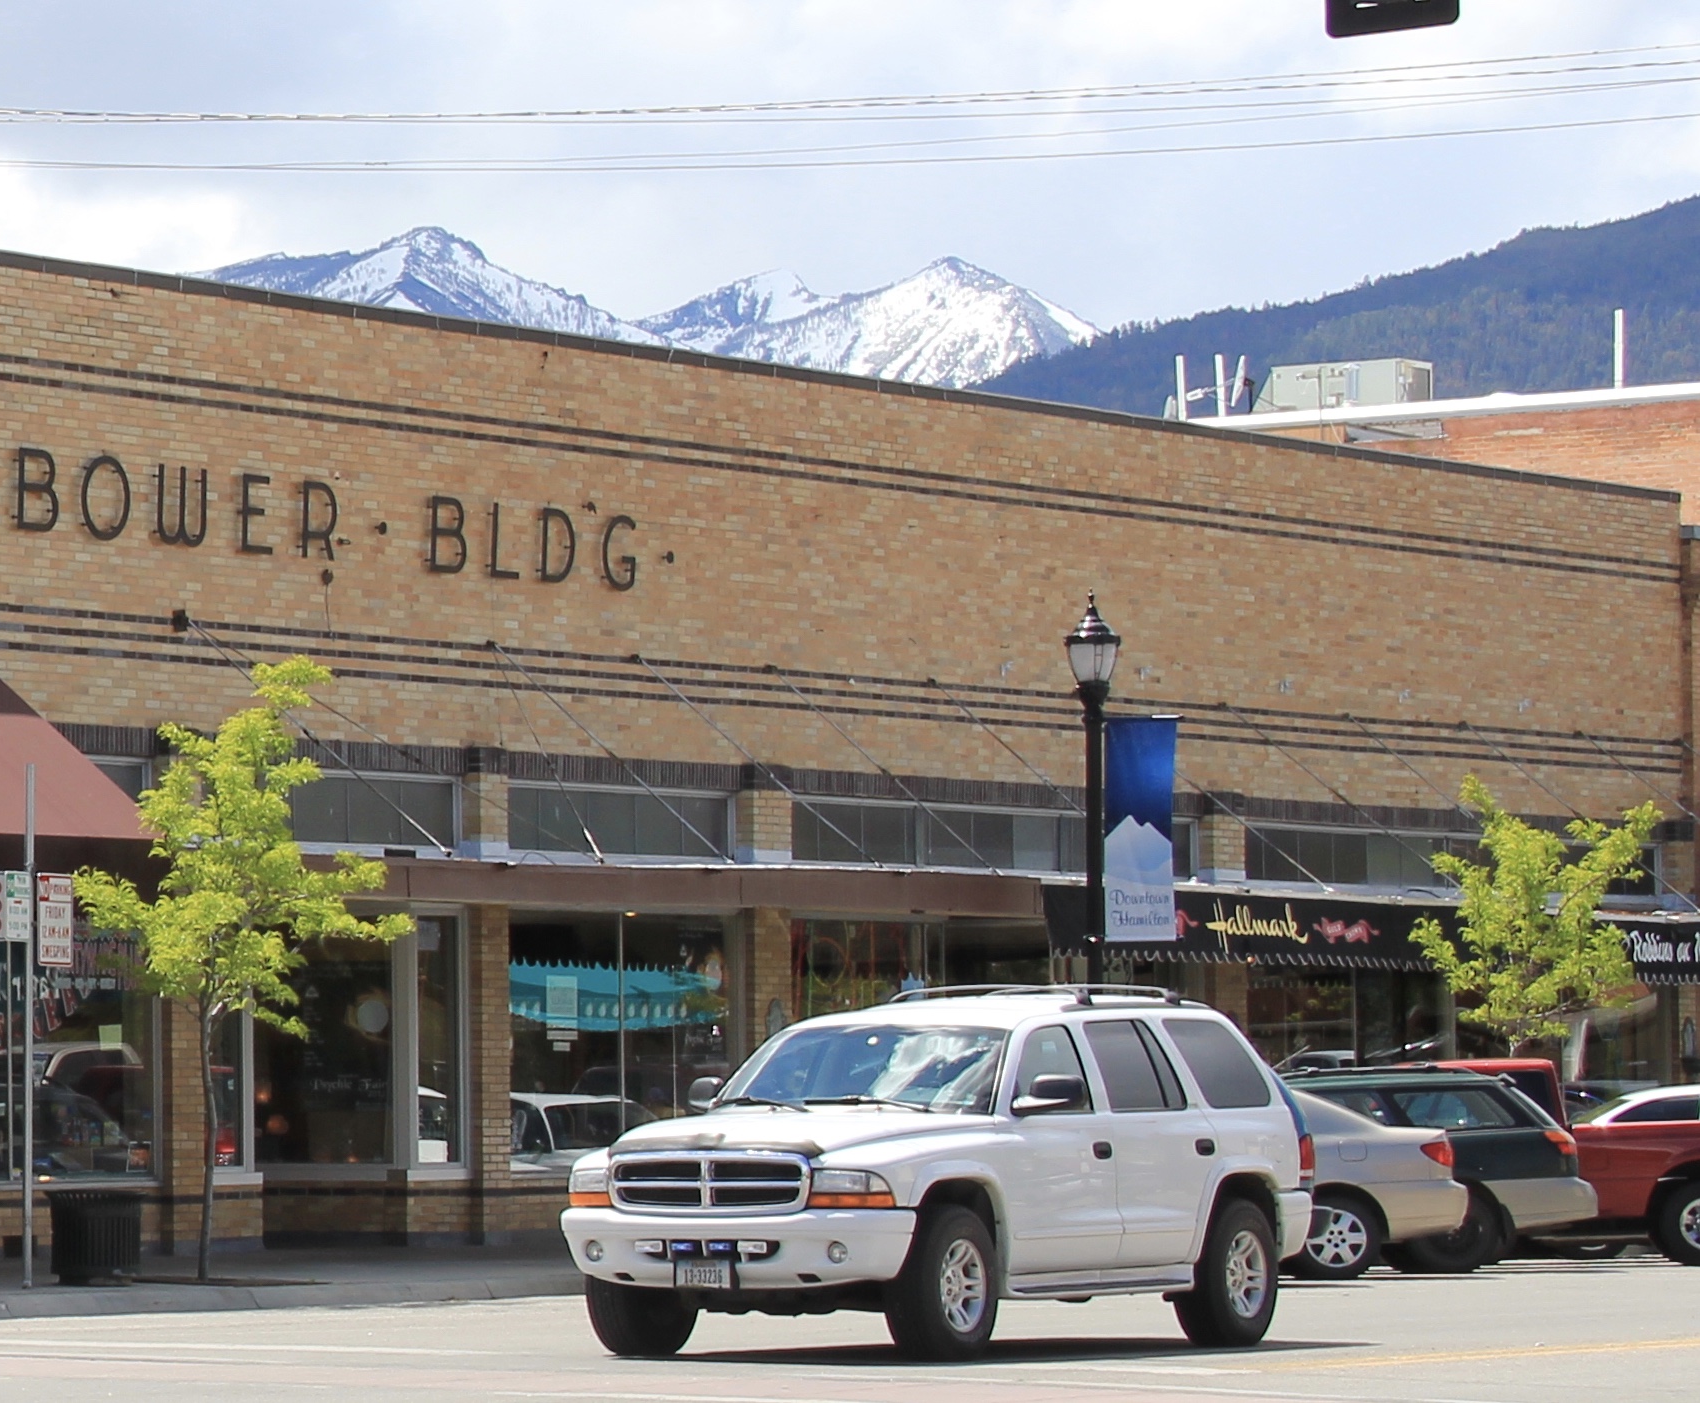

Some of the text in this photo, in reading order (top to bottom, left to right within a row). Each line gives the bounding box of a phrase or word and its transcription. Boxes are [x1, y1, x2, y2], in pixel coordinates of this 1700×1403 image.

[15, 446, 637, 592] BOWER BLDG
[1110, 889, 1170, 907] Downtown
[45, 905, 65, 919] FRIDAY
[1110, 910, 1170, 928] Hamilton
[1205, 897, 1309, 955] Hallmark
[41, 944, 70, 959] SWEEPING
